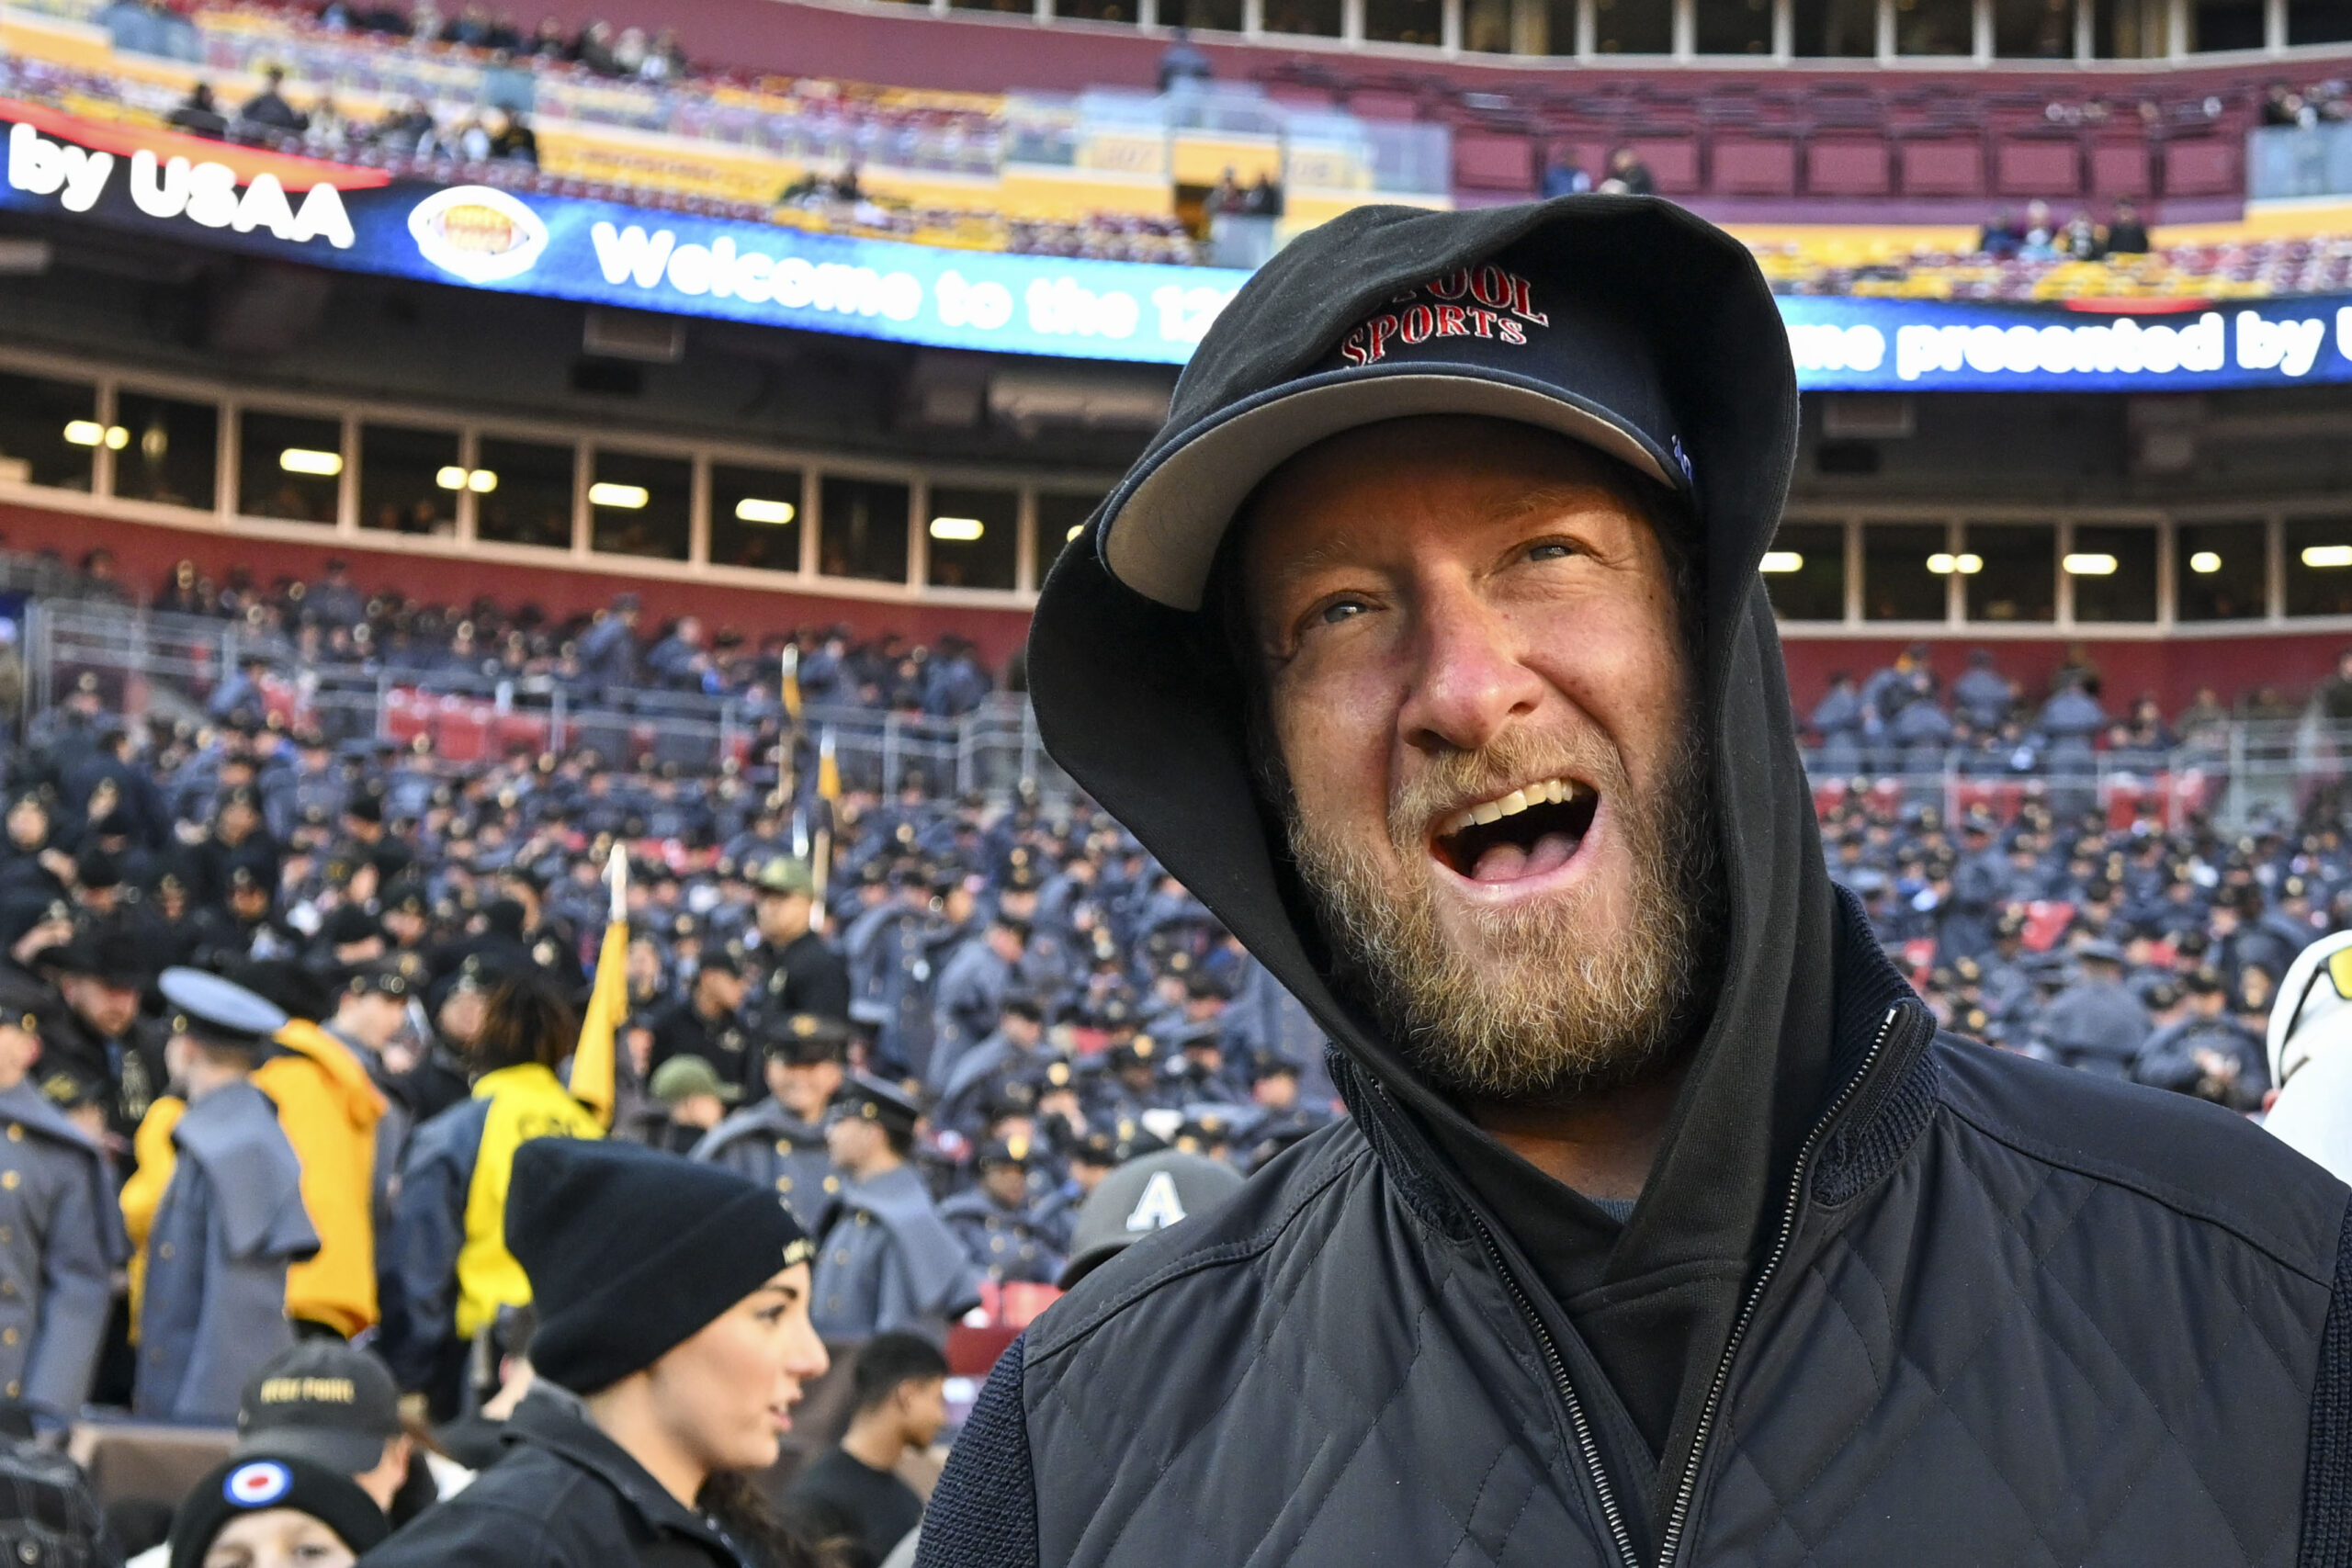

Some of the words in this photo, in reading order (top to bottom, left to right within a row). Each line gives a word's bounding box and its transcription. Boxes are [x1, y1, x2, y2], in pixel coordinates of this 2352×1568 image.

[8, 123, 113, 212] by
[130, 150, 356, 249] USAA
[591, 220, 922, 321] Welcome
[935, 270, 1012, 330] to
[1025, 276, 1139, 339] the
[1151, 285, 1239, 344] 12
[1896, 312, 2224, 381] presented
[2236, 310, 2325, 377] by
[1341, 303, 1527, 369] SPORTS
[1125, 1170, 1188, 1232] A
